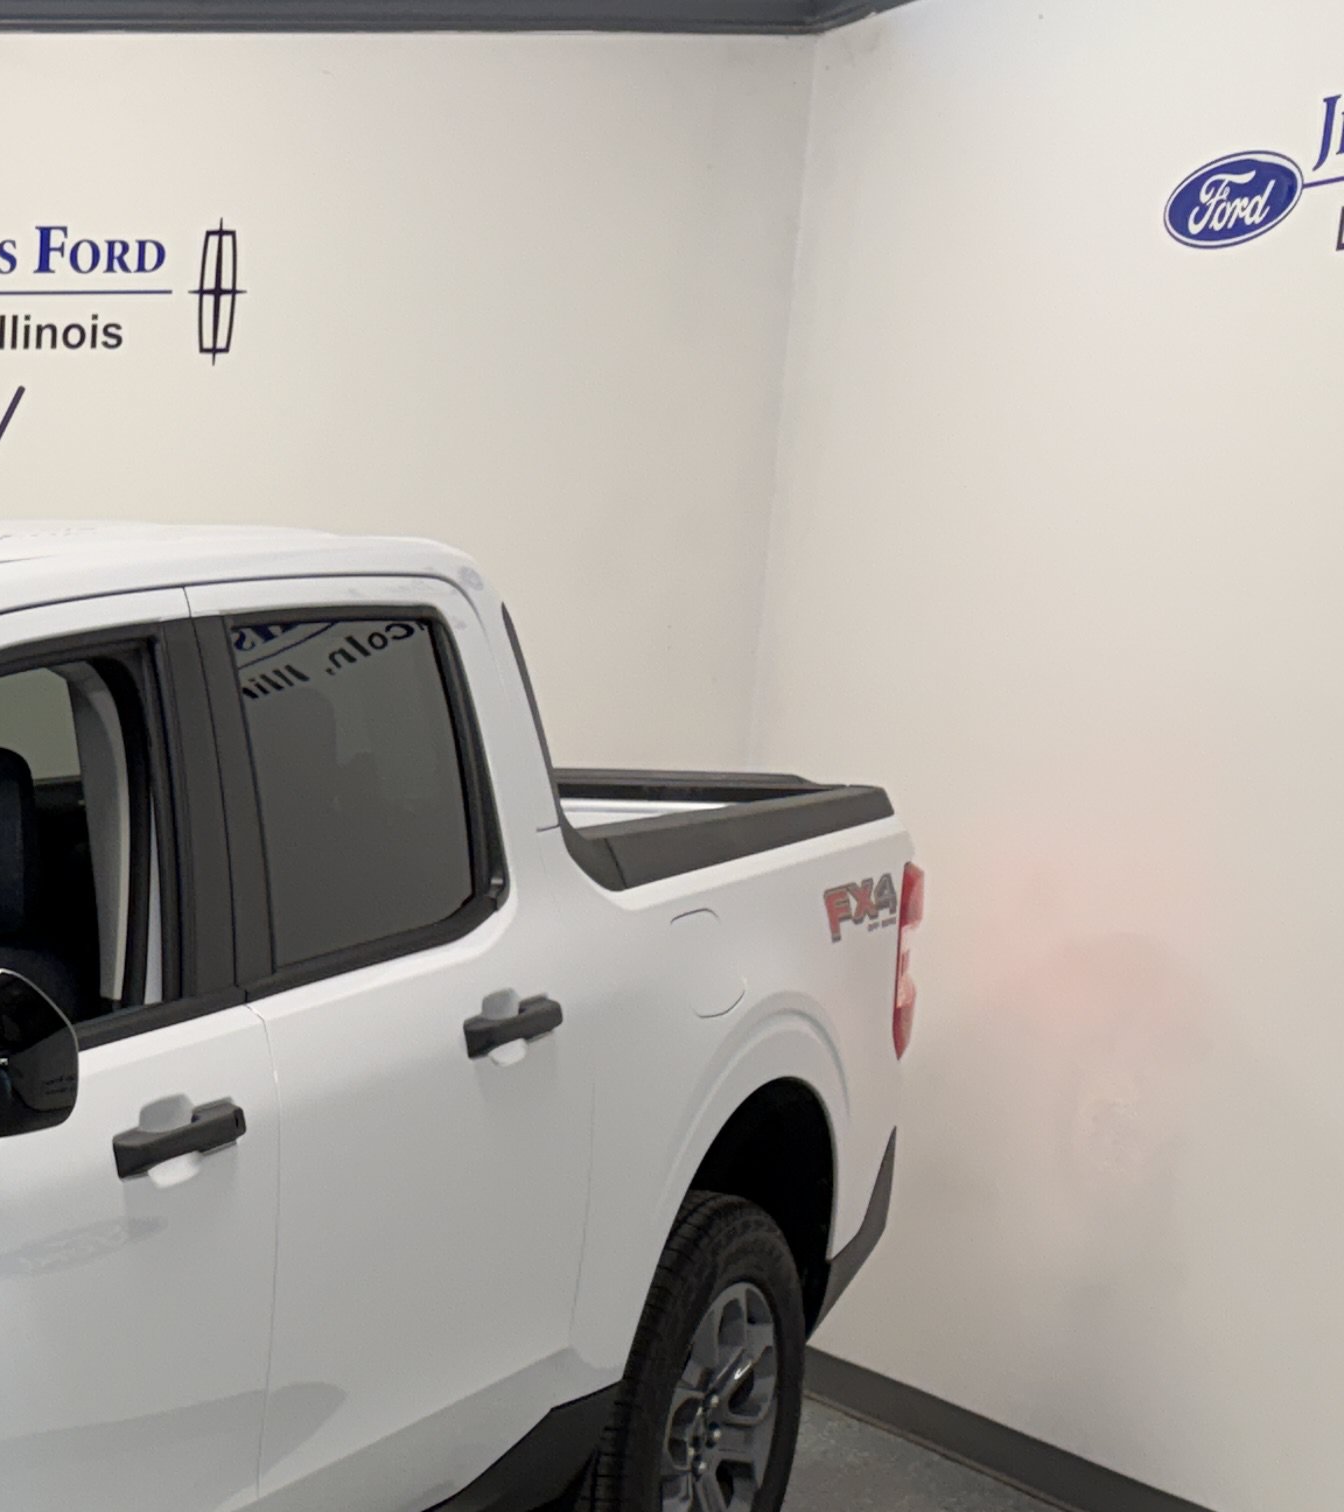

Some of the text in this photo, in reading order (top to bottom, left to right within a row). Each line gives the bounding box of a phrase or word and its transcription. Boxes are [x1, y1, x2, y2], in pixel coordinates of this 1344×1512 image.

[1187, 169, 1276, 235] Ford
[34, 226, 166, 274] FORD
[822, 872, 898, 944] FX4
